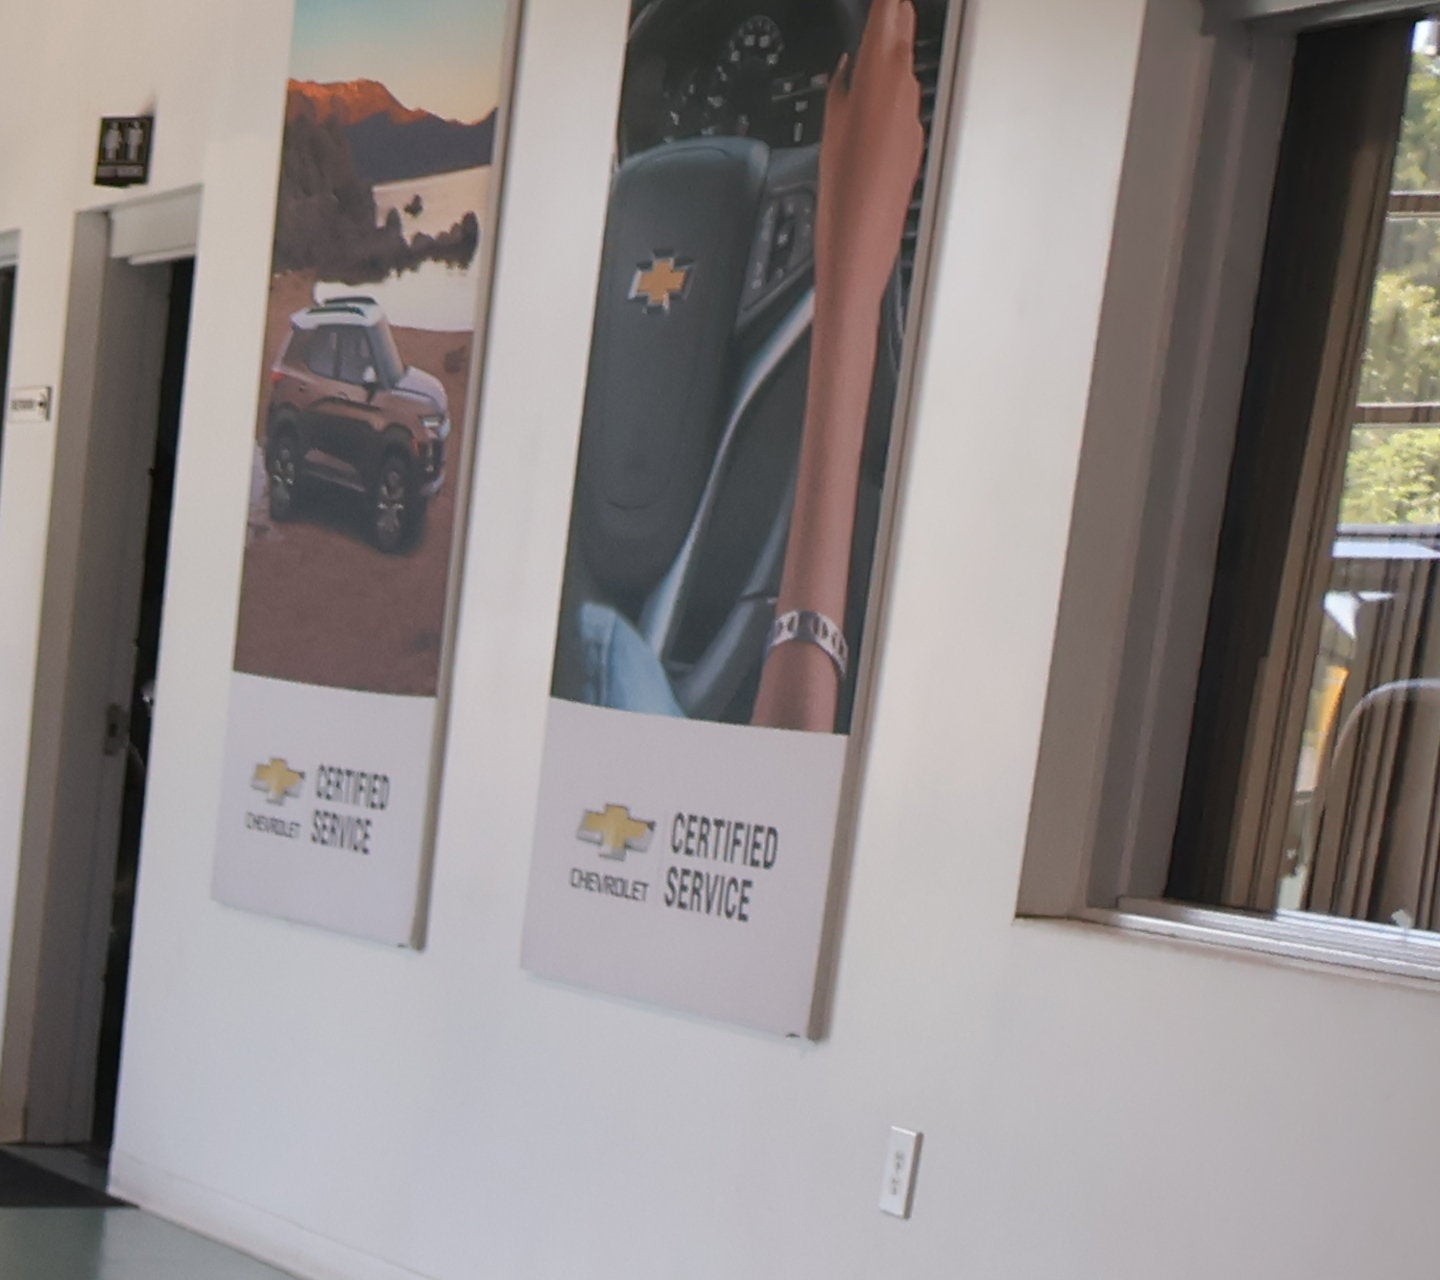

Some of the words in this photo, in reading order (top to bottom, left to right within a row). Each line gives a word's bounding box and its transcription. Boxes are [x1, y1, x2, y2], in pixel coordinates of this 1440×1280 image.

[316, 763, 391, 811] CERTIFIED
[244, 810, 301, 839] CHEVROLET
[310, 808, 373, 855] SERVICE
[670, 811, 779, 870] CERTIFIED
[569, 867, 650, 902] CHEVROLET
[663, 865, 754, 922] SERVICE
